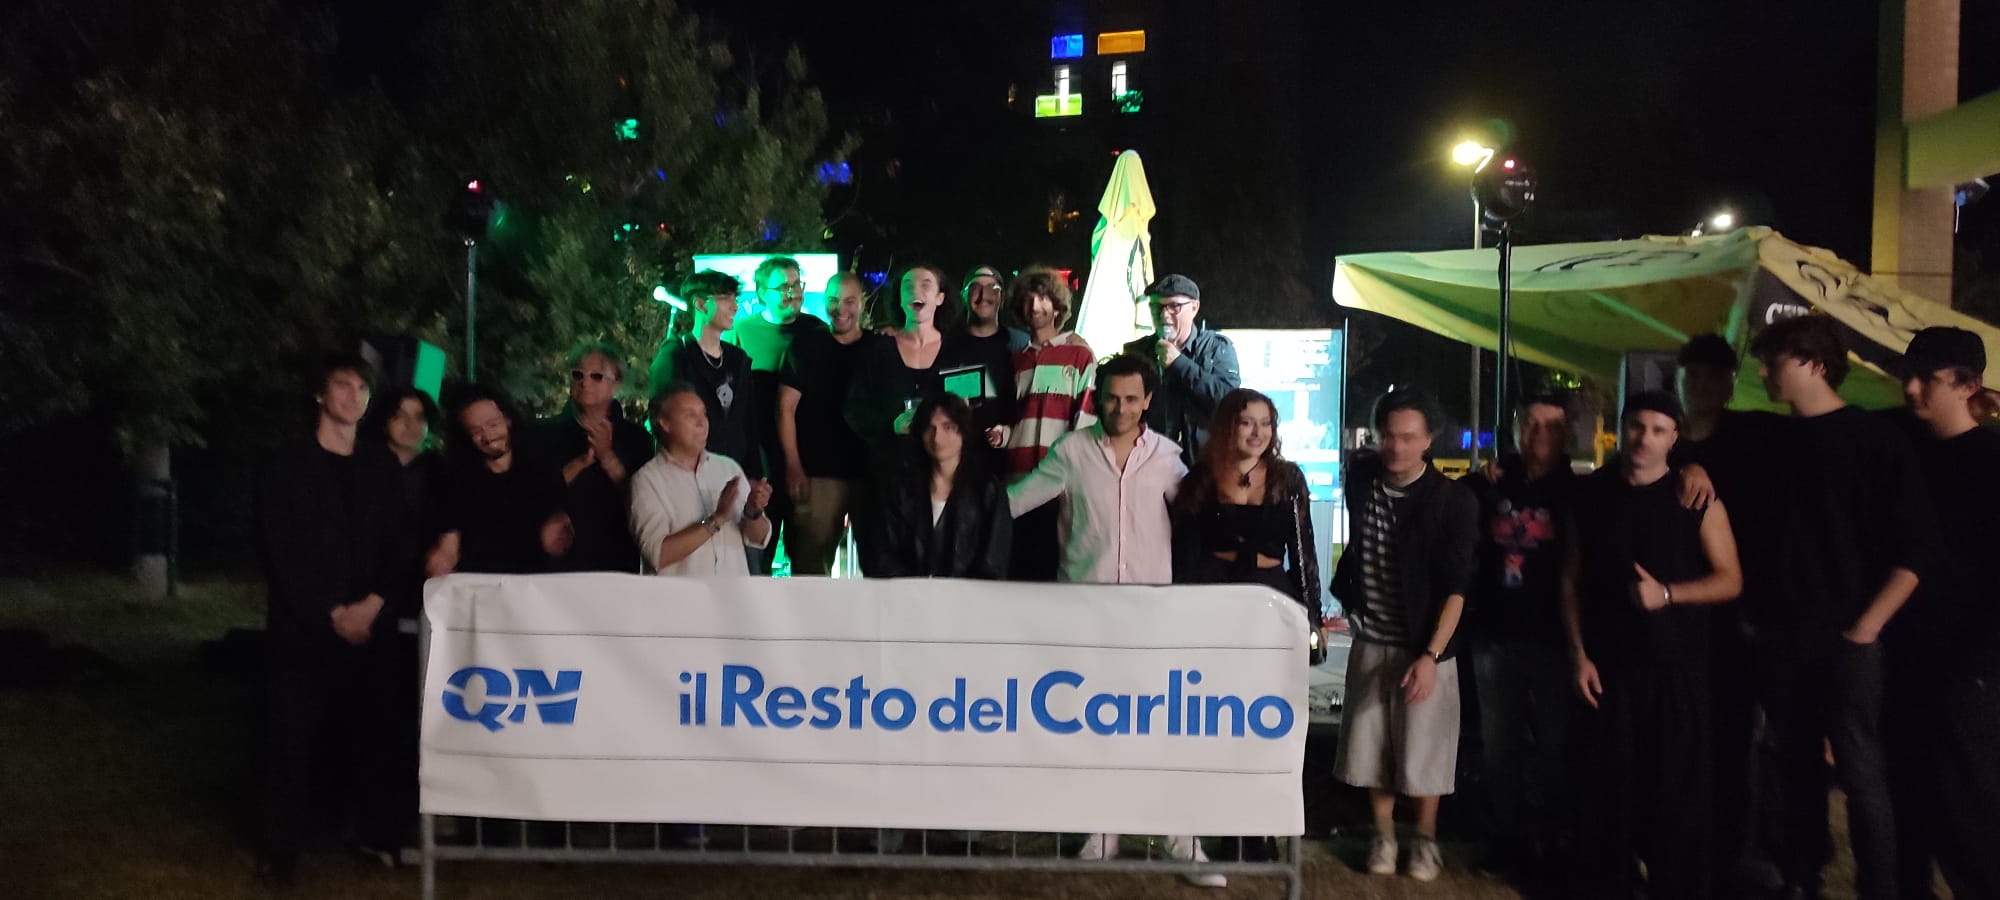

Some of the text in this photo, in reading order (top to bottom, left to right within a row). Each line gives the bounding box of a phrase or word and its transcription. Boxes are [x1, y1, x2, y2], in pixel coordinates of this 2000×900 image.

[442, 666, 582, 732] QN
[679, 664, 1295, 739] il Resto del Carlino
